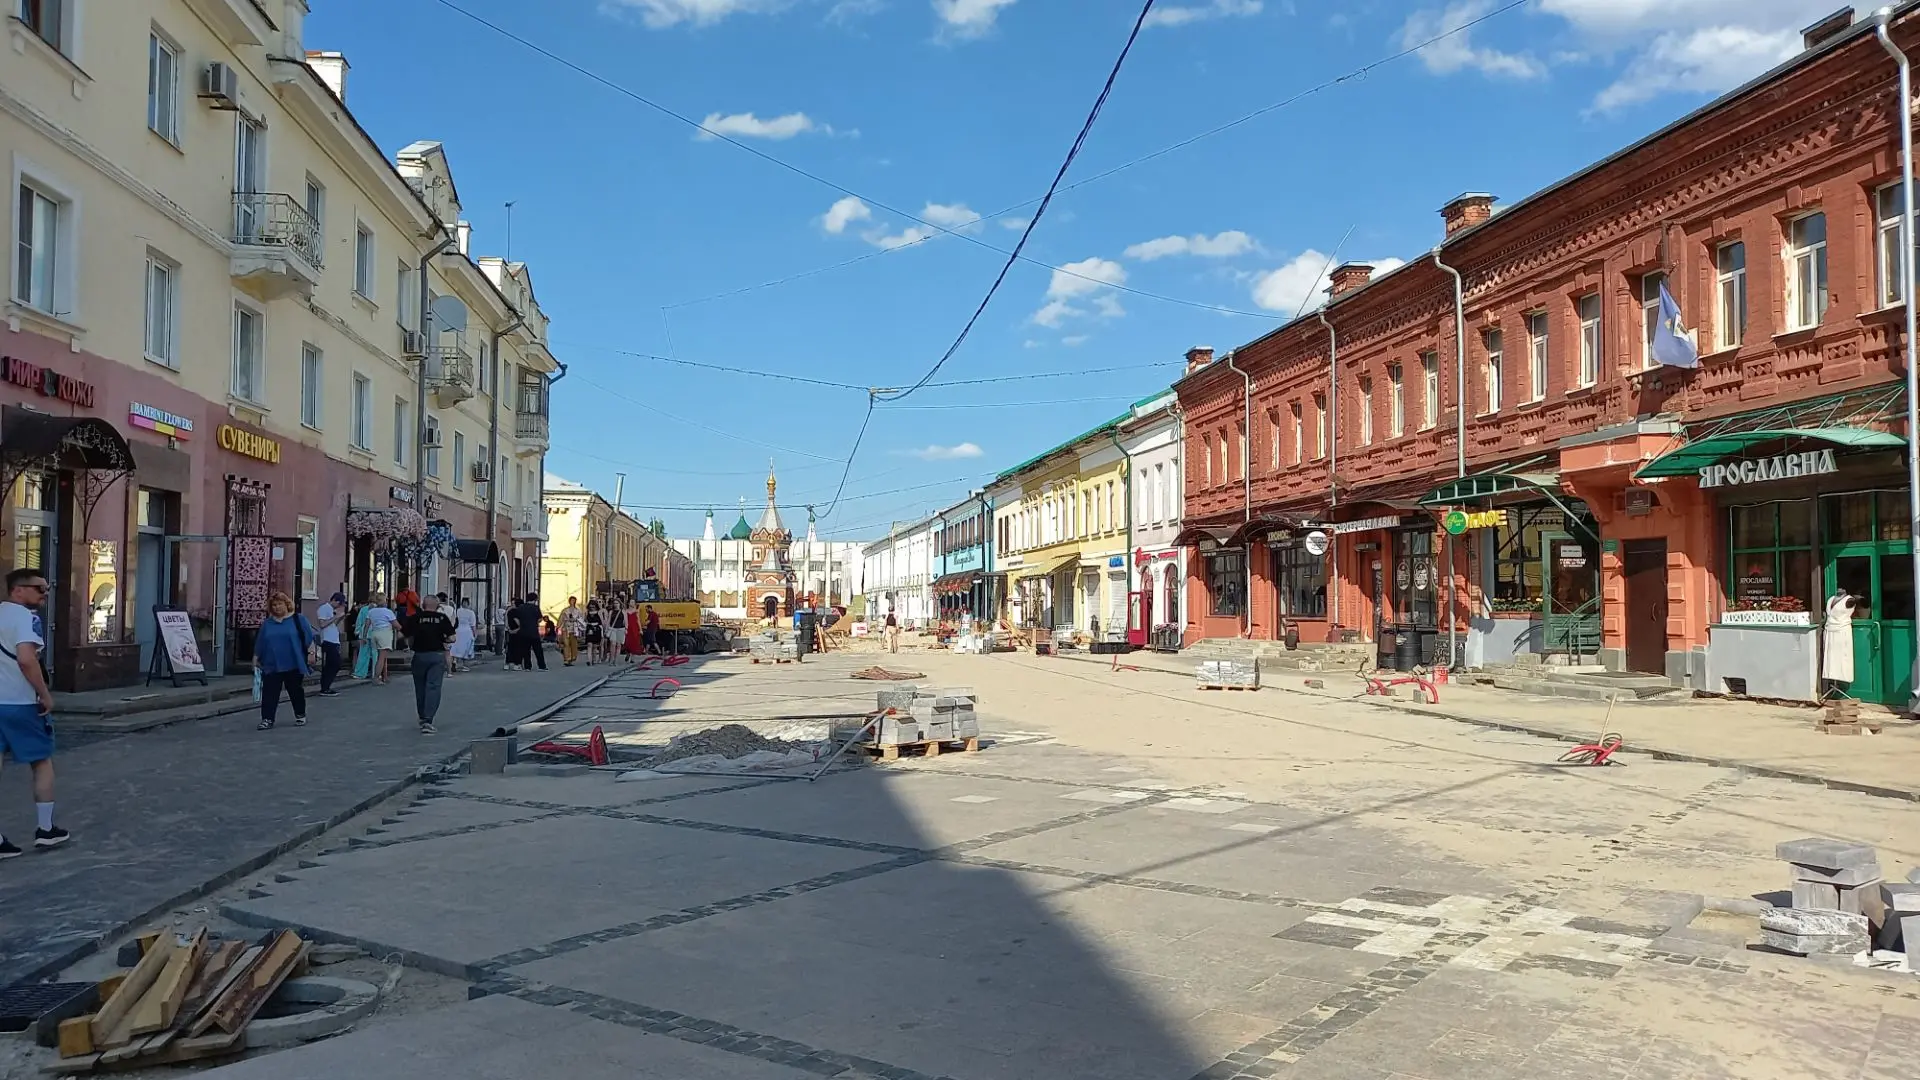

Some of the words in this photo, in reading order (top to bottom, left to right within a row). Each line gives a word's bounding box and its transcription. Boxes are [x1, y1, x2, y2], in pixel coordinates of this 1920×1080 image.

[8, 359, 40, 388] МИР
[59, 375, 95, 408] КОЖИ
[133, 402, 164, 421] BAMBINI
[164, 412, 193, 431] FLOWERS
[219, 424, 281, 464] СУВЕНИРЫ
[1698, 448, 1840, 488] ЯРОСЛАВНА
[162, 615, 186, 623] ЦВЕТЫ
